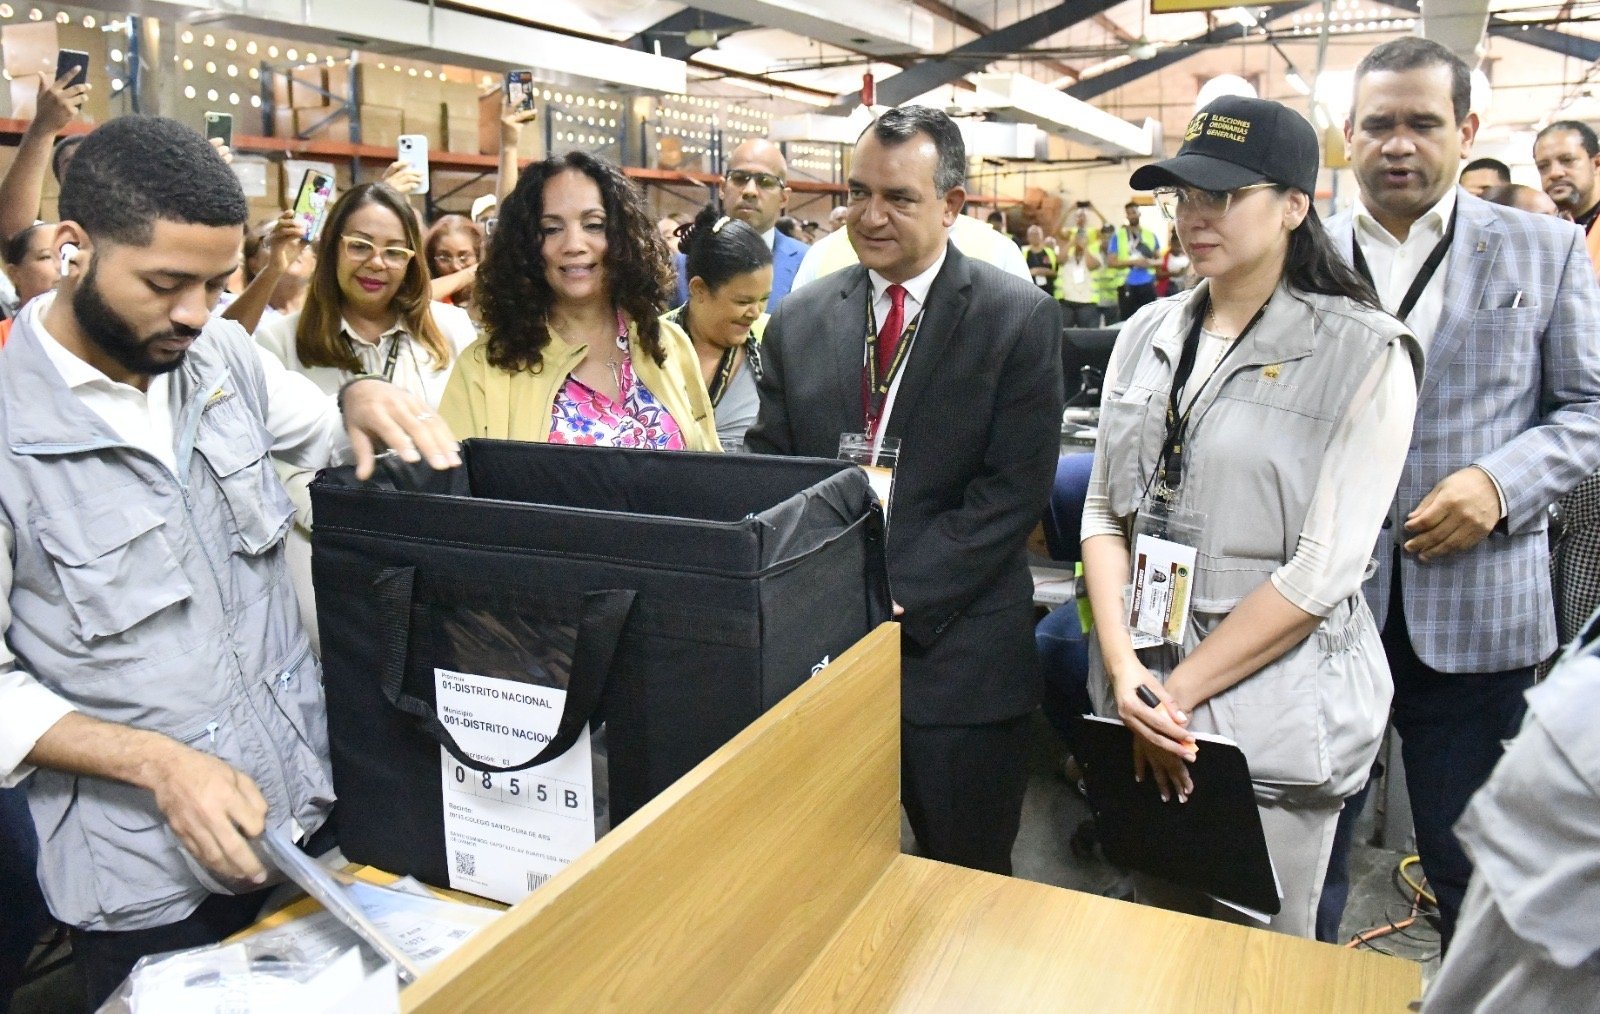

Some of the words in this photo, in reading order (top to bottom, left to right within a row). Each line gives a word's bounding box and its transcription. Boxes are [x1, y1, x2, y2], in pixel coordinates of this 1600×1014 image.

[1209, 121, 1248, 135] ORDINARIAS
[1211, 114, 1250, 128] ELECCIONES
[1206, 128, 1245, 143] GENERALES
[442, 680, 499, 698] 01-DISTRITO
[502, 691, 552, 709] NACIONAL
[444, 714, 509, 735] 001-DISTRITO
[512, 728, 552, 744] NACION
[482, 770, 492, 790] 8
[510, 778, 520, 796] 5
[537, 784, 547, 802] 5
[564, 789, 578, 809] B
[490, 822, 511, 832] SANTO
